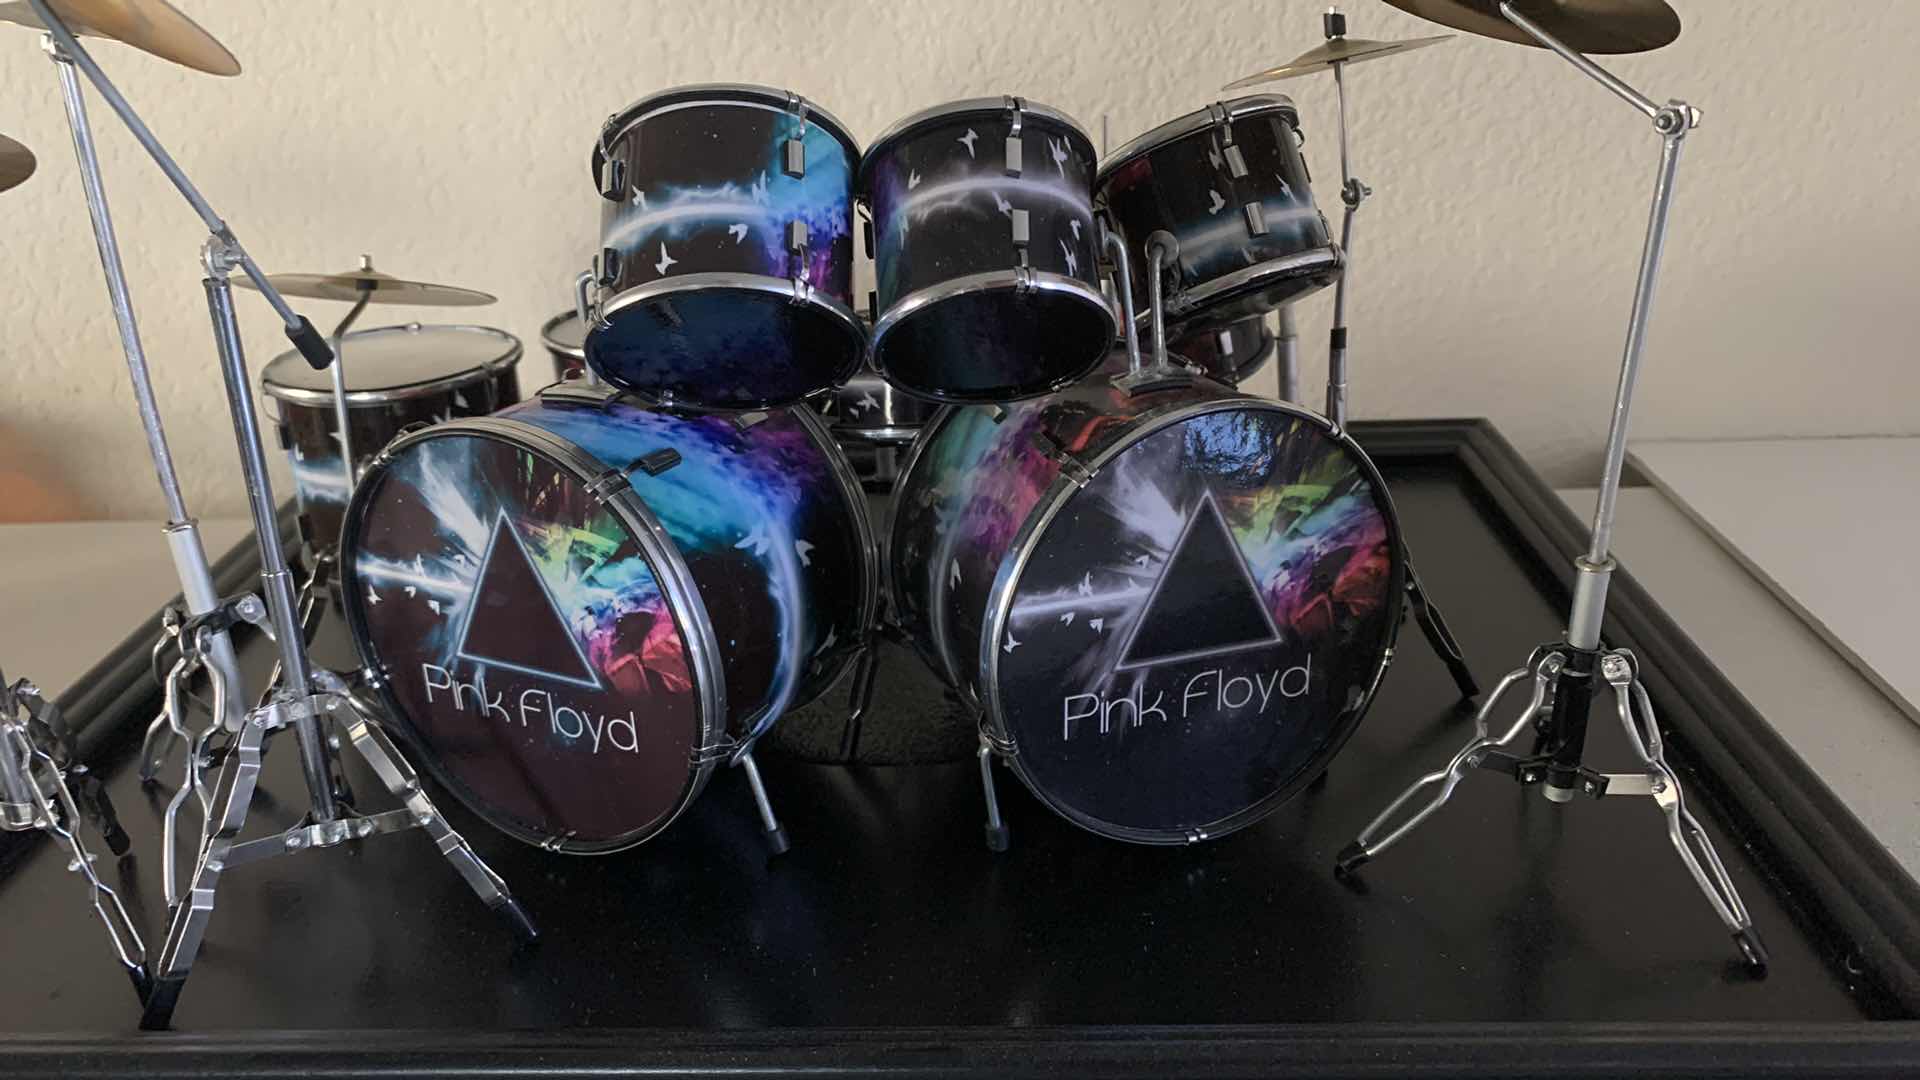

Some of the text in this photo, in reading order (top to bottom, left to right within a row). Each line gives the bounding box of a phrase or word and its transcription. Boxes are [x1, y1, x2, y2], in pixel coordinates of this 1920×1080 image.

[422, 663, 639, 754] Pink Floyd
[1064, 652, 1312, 741] Pink Floyd
